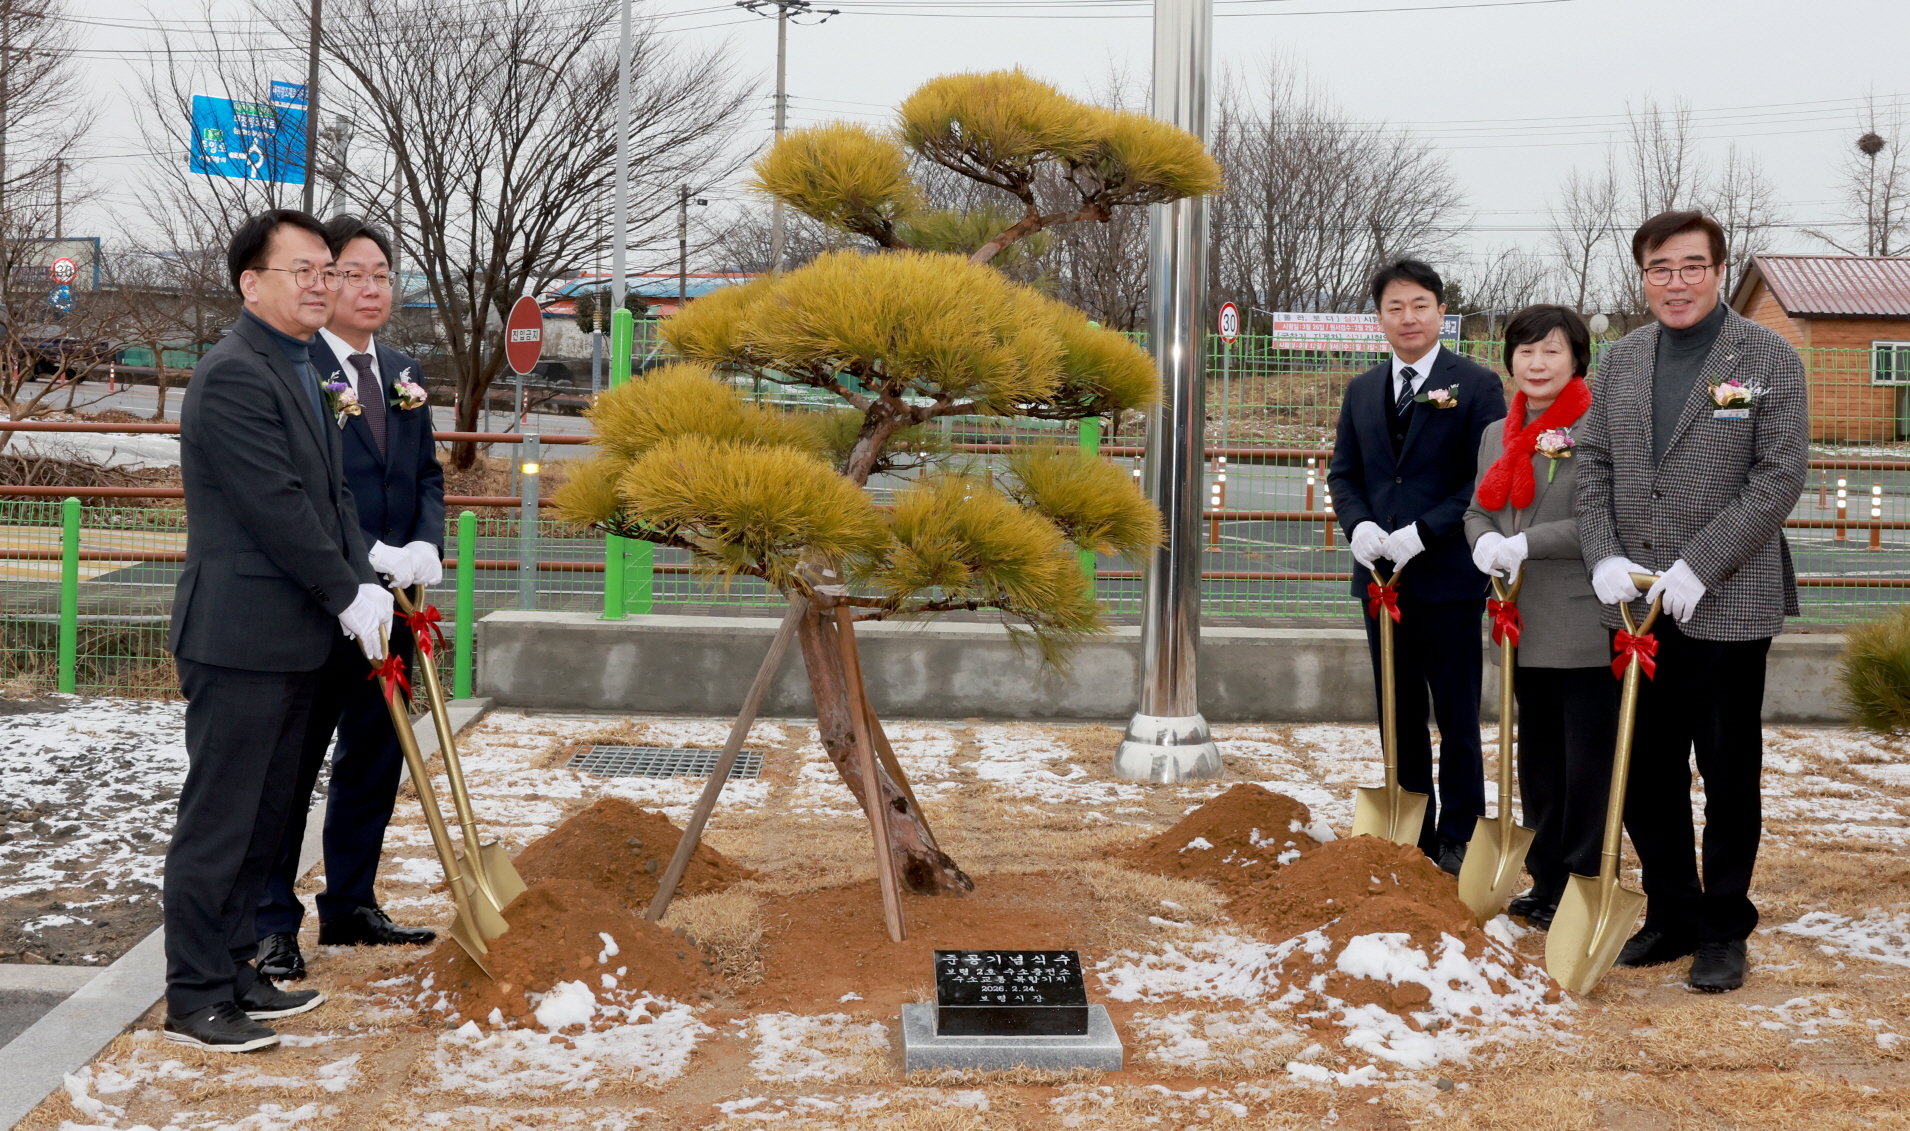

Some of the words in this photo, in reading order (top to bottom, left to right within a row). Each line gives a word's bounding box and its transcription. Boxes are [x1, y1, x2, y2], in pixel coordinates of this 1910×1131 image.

[56, 264, 73, 277] 30
[1222, 313, 1237, 333] 30
[1344, 315, 1361, 323] 실기
[512, 329, 539, 341] 진입금지
[942, 954, 1070, 966] 준공기념식수
[945, 968, 969, 976] 보령
[976, 968, 997, 976] 2호
[1003, 968, 1071, 976] 수소충전소
[952, 975, 1006, 984] 수소교통
[1013, 975, 1067, 984] 복합기지
